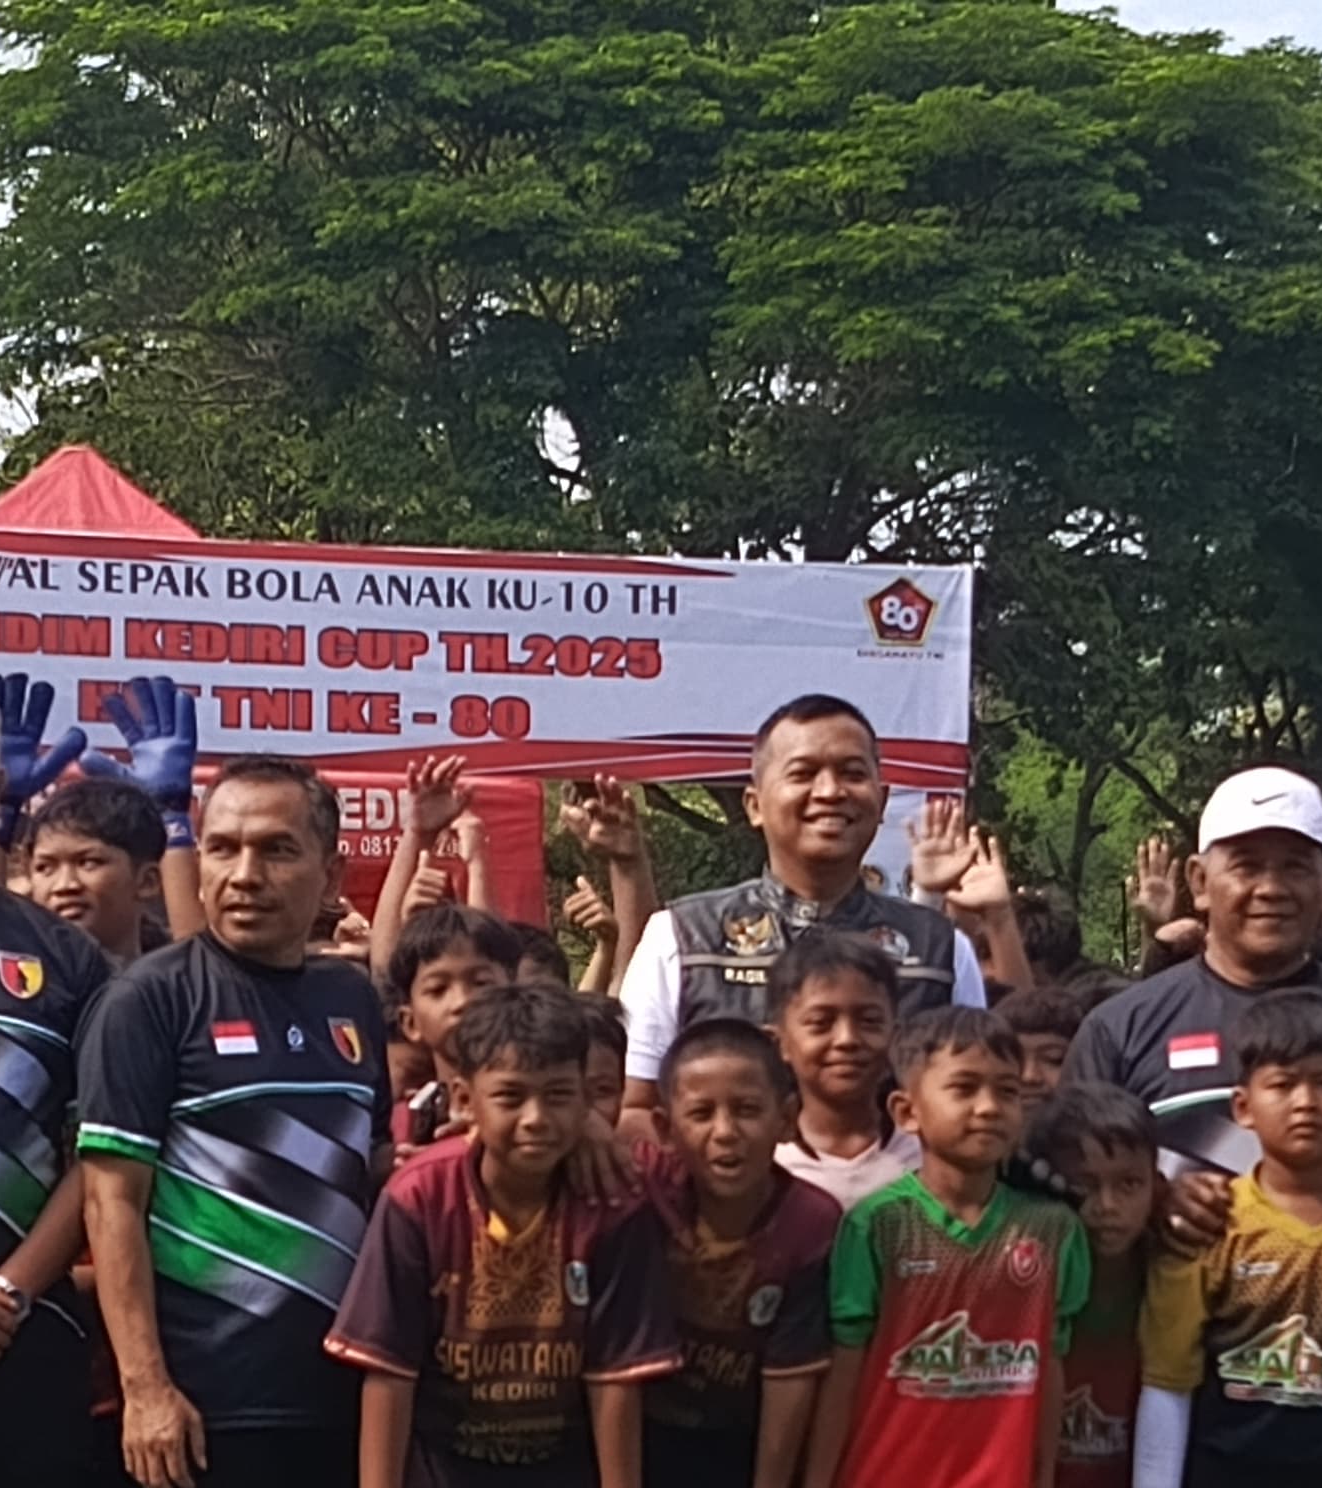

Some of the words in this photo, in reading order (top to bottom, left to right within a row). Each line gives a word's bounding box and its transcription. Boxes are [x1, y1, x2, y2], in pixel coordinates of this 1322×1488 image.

[77, 558, 210, 599] SEPAK
[225, 562, 340, 605] BOLA
[355, 572, 473, 609] ANAK
[487, 576, 610, 616] KU-10
[624, 582, 678, 617] TH
[880, 595, 919, 631] 80
[124, 617, 306, 667] KEDIRI
[317, 625, 430, 671] CUP
[438, 631, 663, 681] TH.2025
[210, 686, 314, 732] TNI
[327, 690, 402, 735] KE
[448, 695, 532, 740] 80
[472, 1381, 558, 1402] KEDIRI
